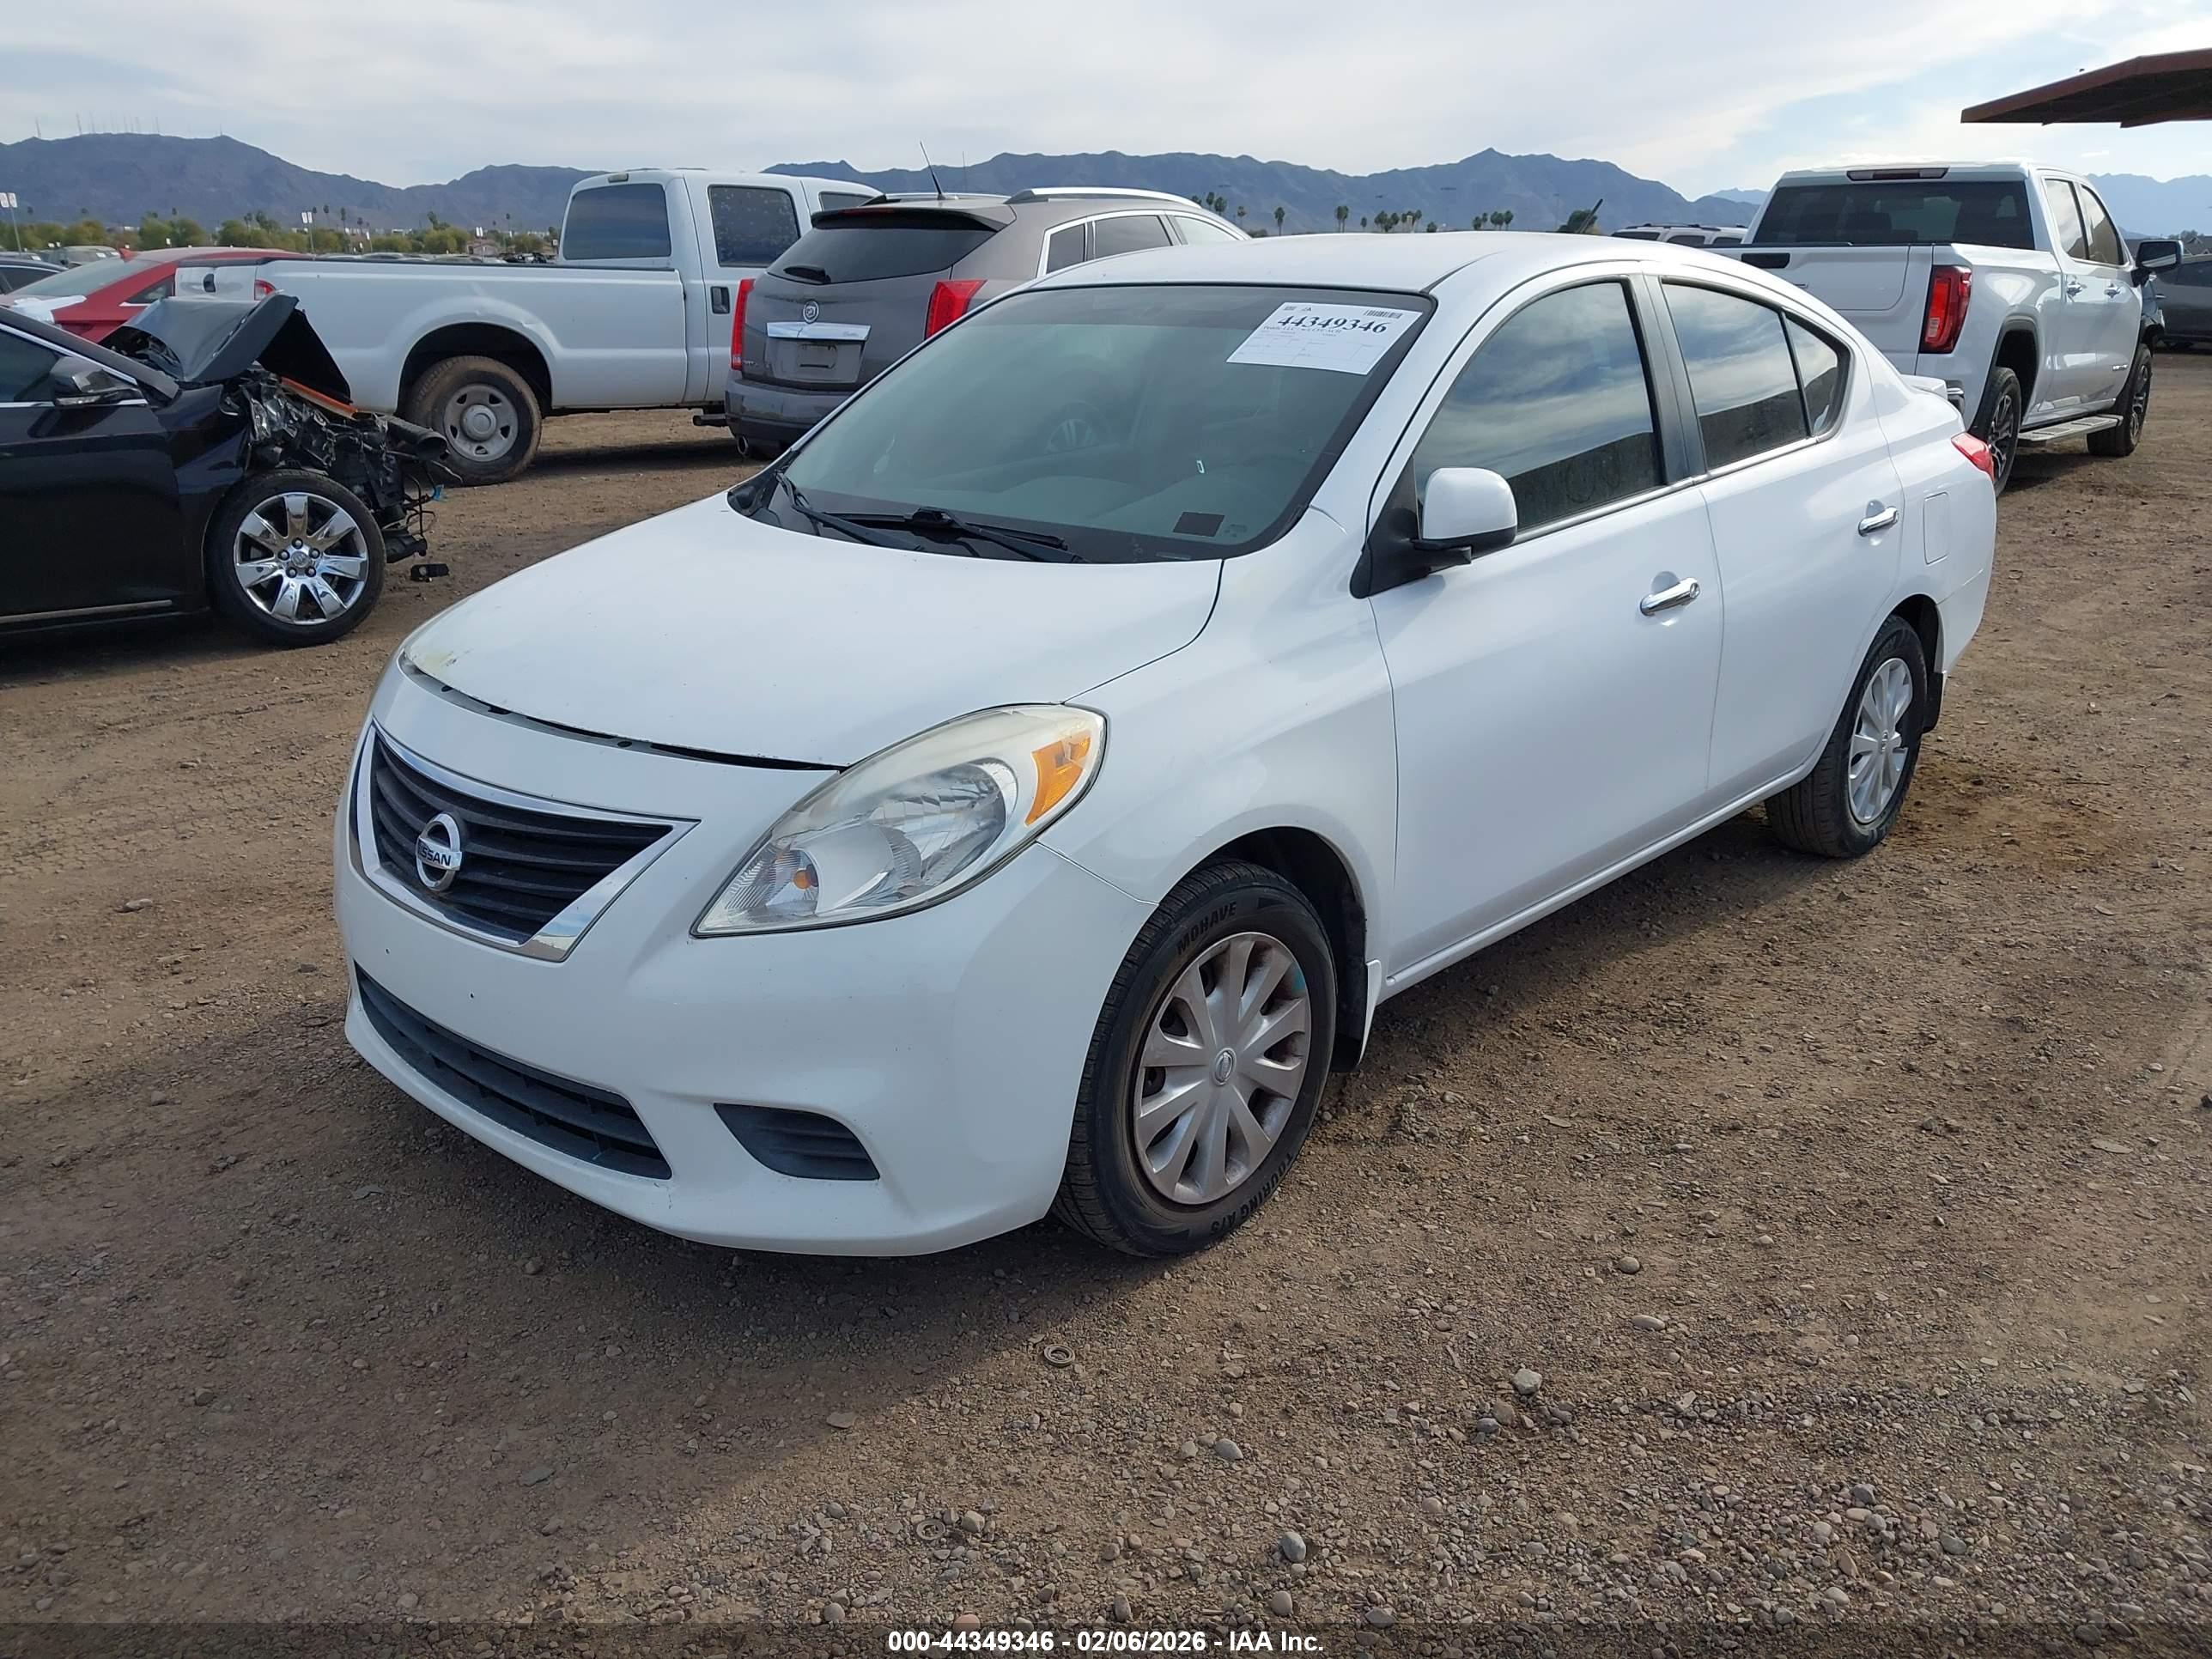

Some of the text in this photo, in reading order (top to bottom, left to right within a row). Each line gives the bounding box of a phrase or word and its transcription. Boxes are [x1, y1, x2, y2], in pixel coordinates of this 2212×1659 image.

[1278, 315, 1390, 333] 44349346
[1177, 901, 1237, 956] MOHAVE
[1240, 1153, 1293, 1218] TOURING
